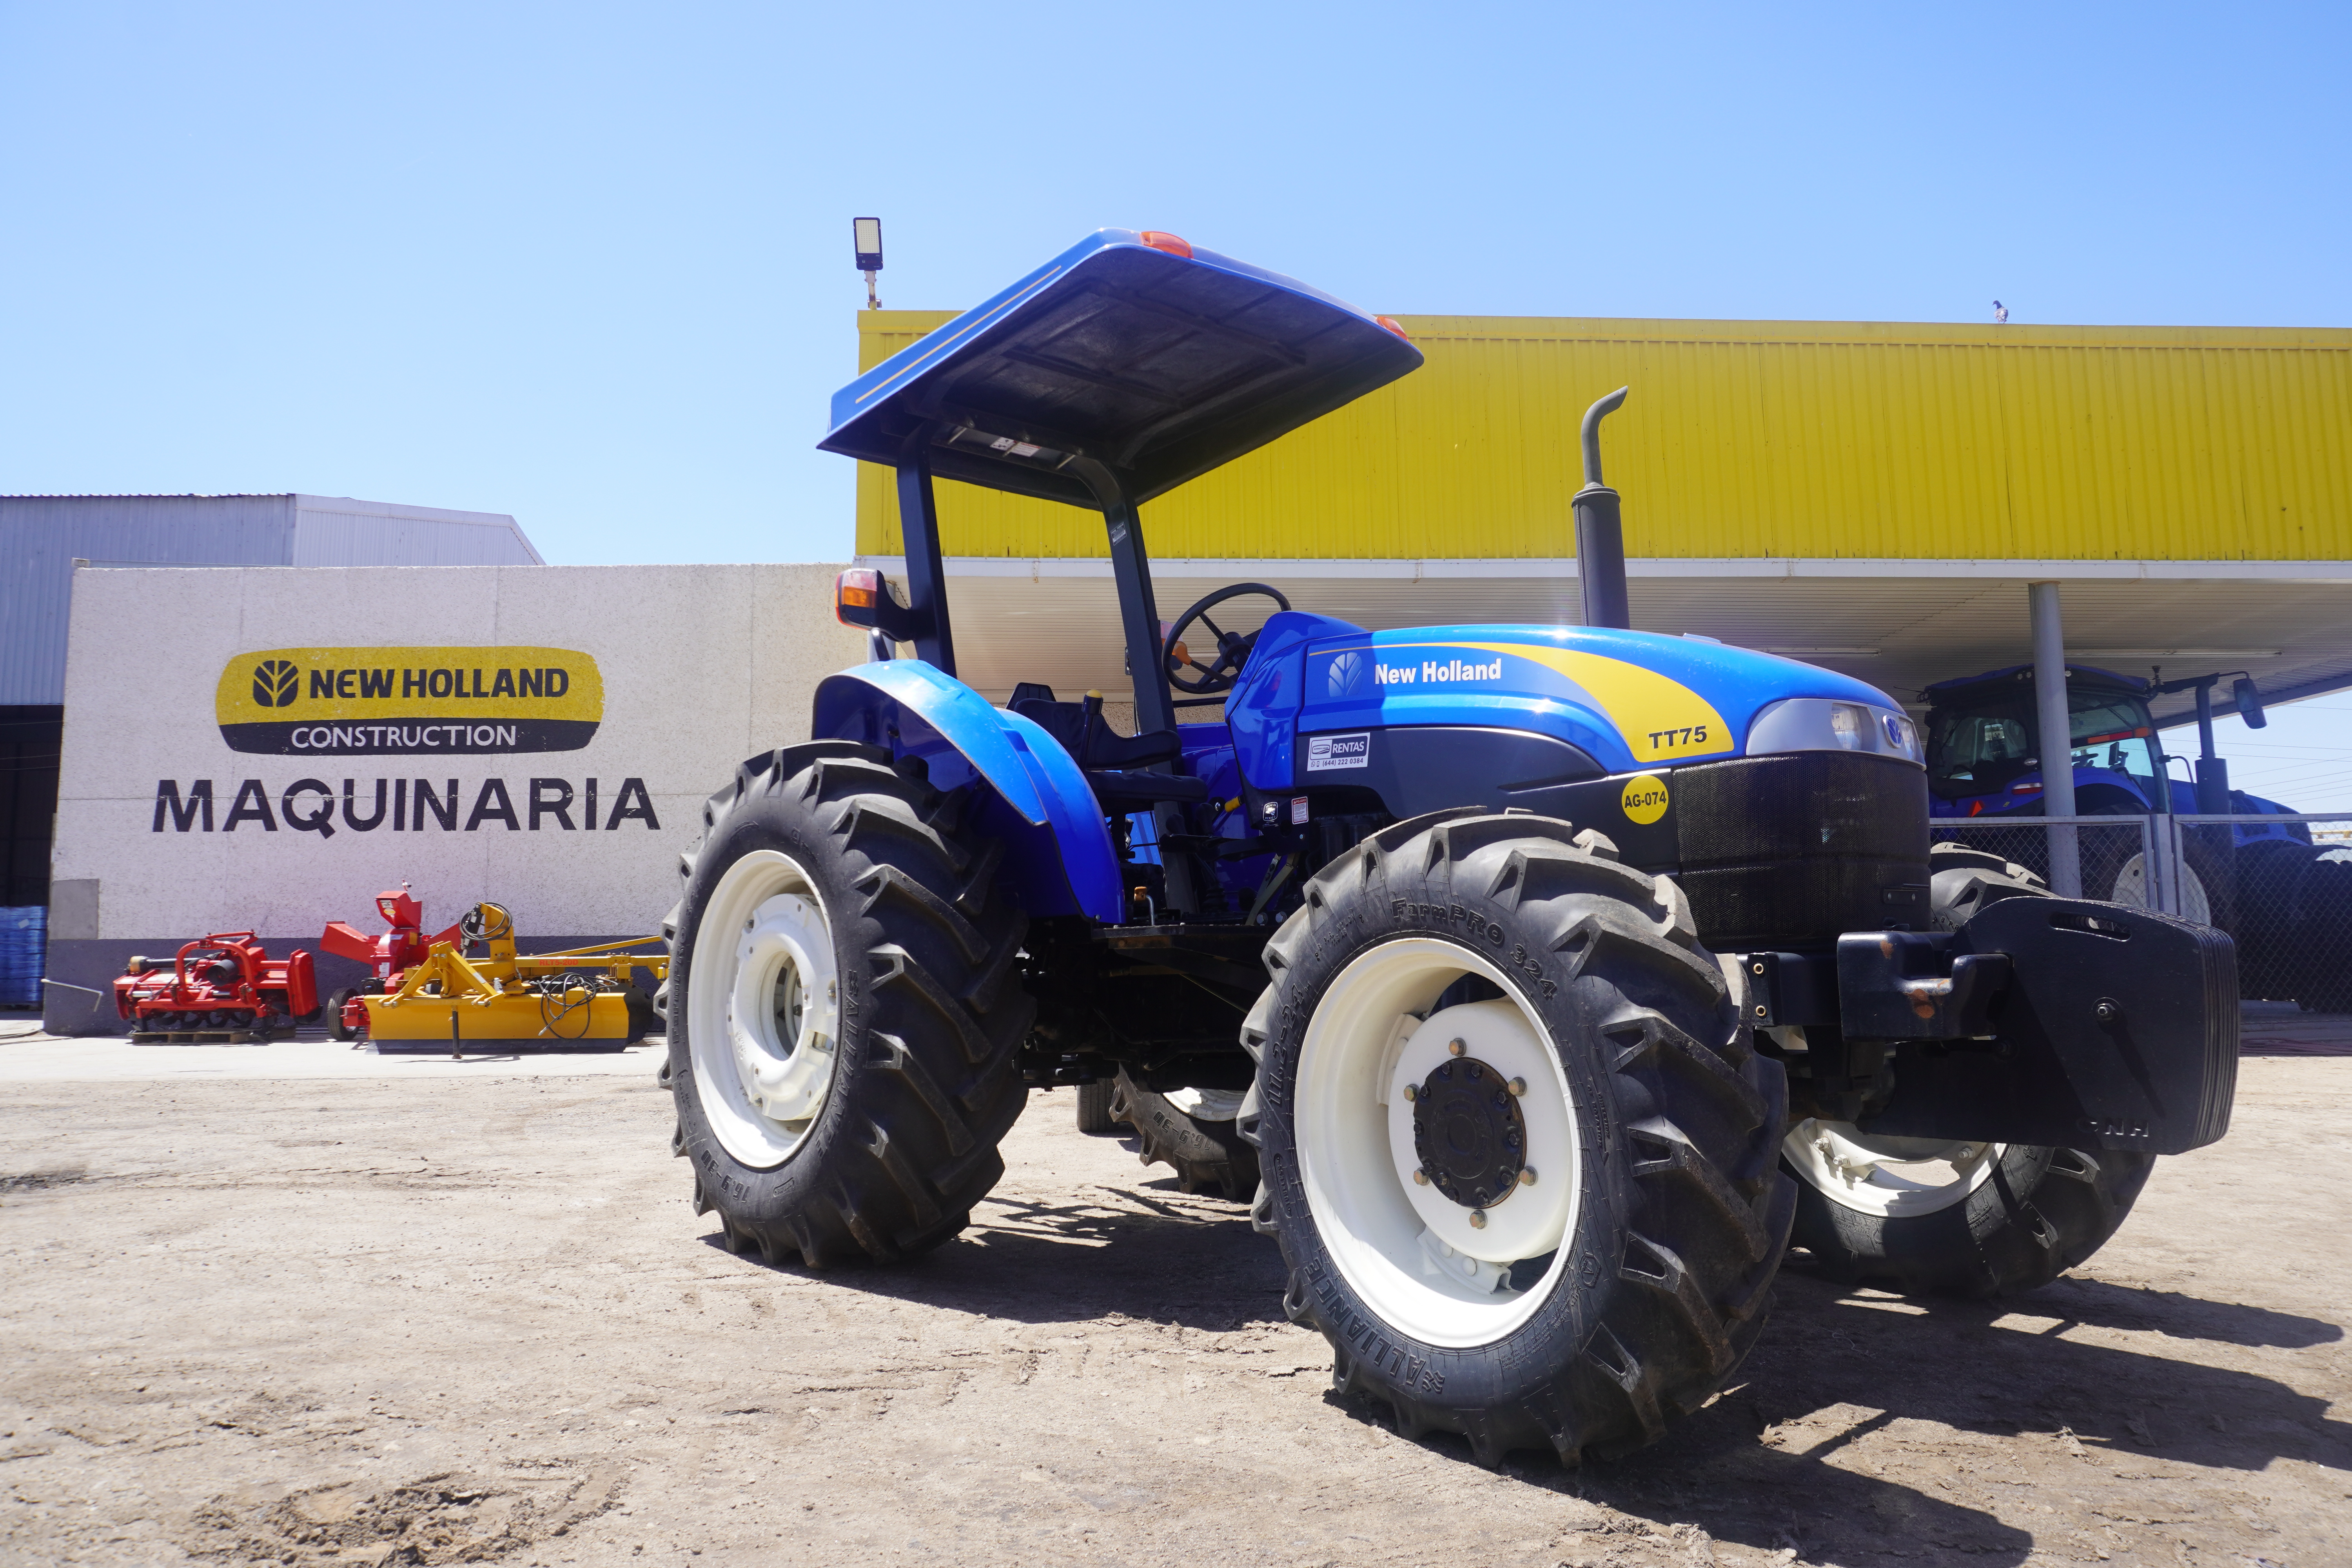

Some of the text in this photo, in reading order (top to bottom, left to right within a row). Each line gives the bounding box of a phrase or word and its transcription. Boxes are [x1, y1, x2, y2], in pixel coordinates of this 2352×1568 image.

[310, 668, 570, 699] NEW HOLLAND
[1375, 658, 1502, 685] New Holland
[291, 725, 516, 748] CONSTRUCTION
[1332, 741, 1365, 754] RENTAS
[1648, 726, 1708, 750] TT75
[152, 778, 661, 840] MAQUINARIA
[1624, 789, 1667, 809] AG-074
[1390, 898, 1558, 1000] FarmPRO 324
[1268, 983, 1305, 1105] 11.2-24
[815, 994, 859, 1160] ALLIANCE
[2076, 1117, 2149, 1137] CNH
[1303, 1257, 1426, 1387] ALLIANCE
